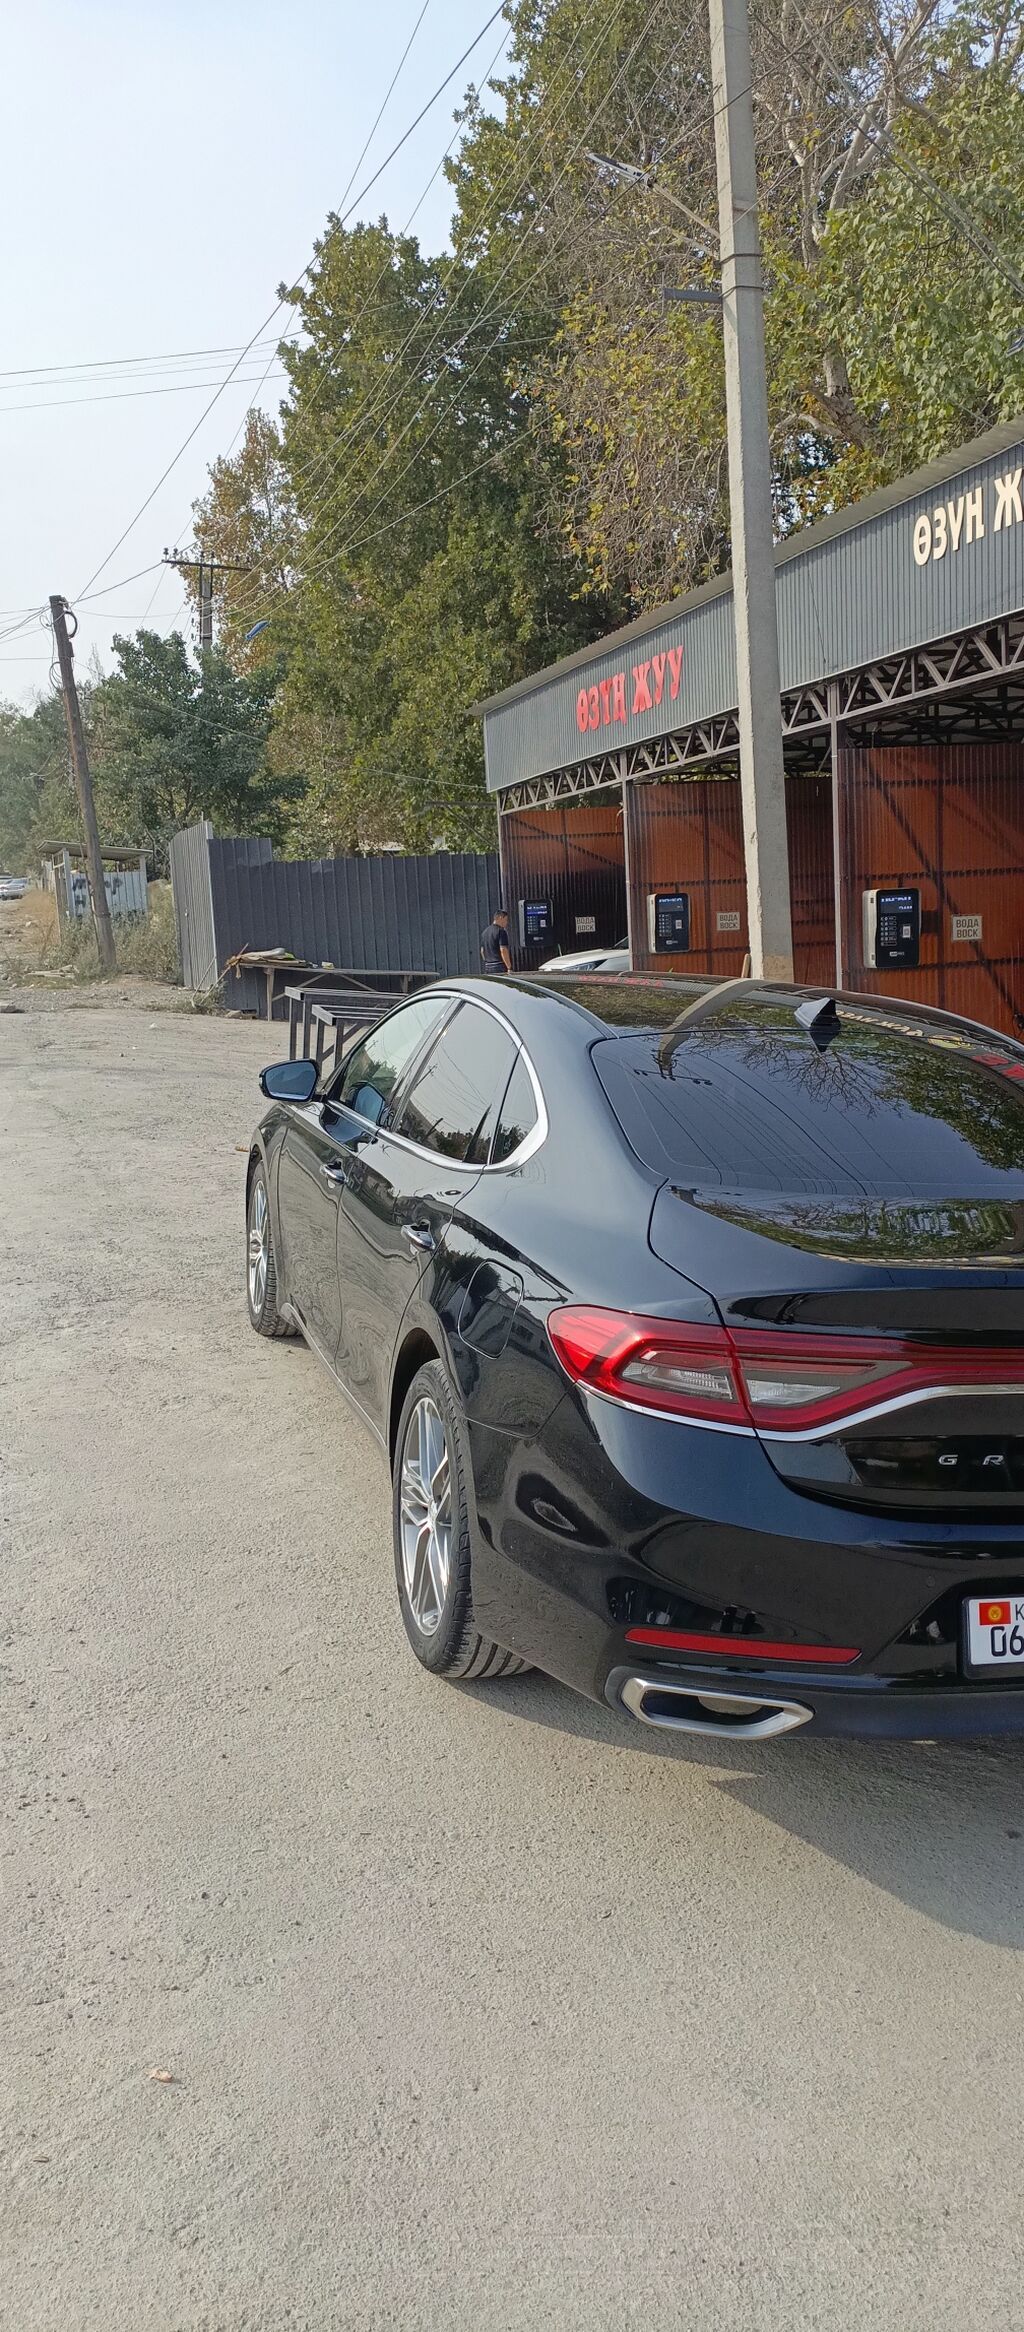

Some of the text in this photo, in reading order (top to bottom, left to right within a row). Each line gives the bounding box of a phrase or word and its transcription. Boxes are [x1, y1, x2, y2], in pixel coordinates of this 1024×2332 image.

[632, 644, 684, 715] ЖУУ
[956, 919, 979, 928] ВОДА
[956, 929, 978, 938] ВОСК
[990, 1625, 1024, 1657] 06
